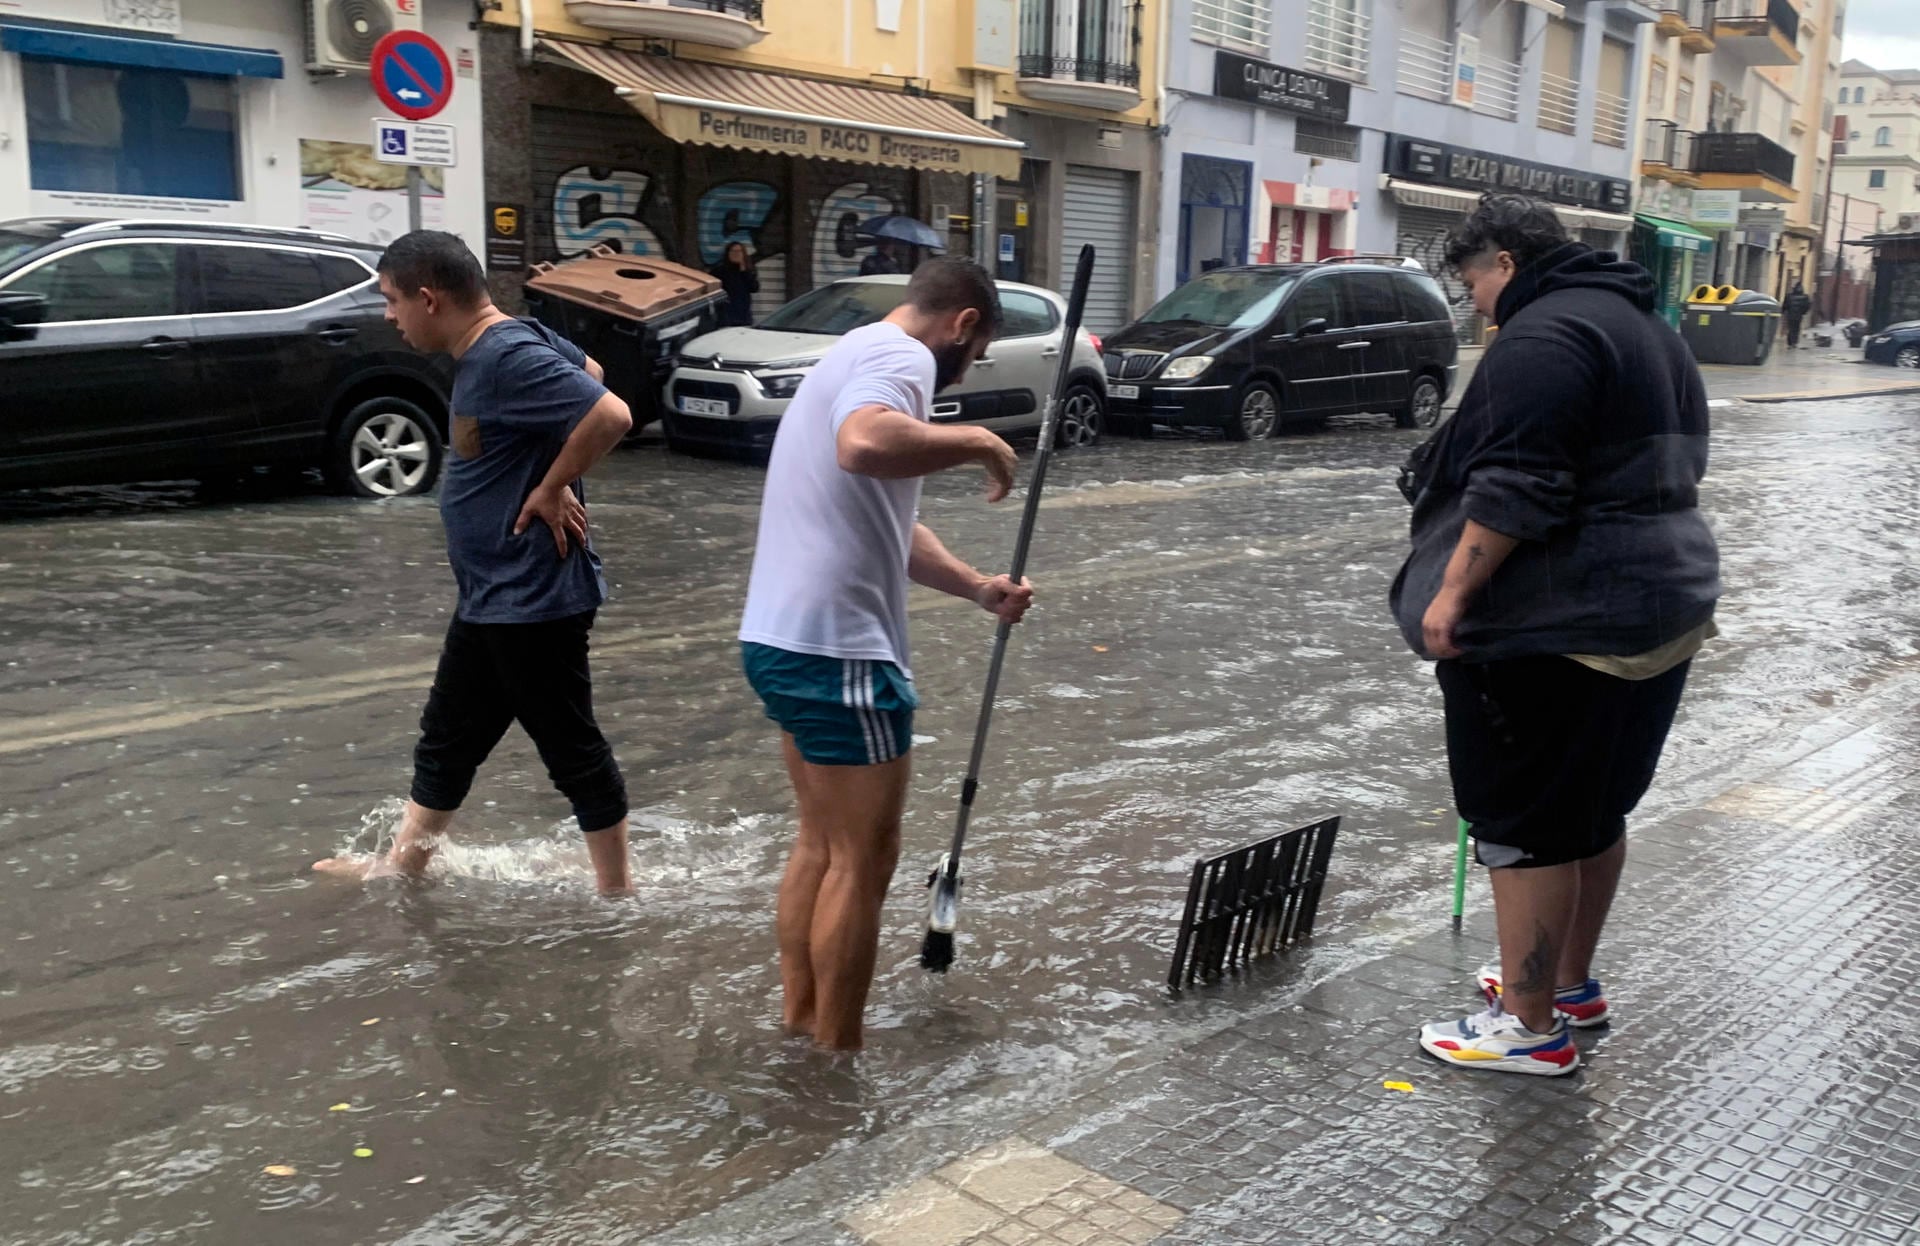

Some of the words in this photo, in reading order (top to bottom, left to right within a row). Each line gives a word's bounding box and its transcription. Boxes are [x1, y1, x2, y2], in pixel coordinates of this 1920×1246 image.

[1288, 73, 1330, 100] DENTAL
[820, 127, 870, 153] PACO
[1450, 152, 1499, 184] BAZAR
